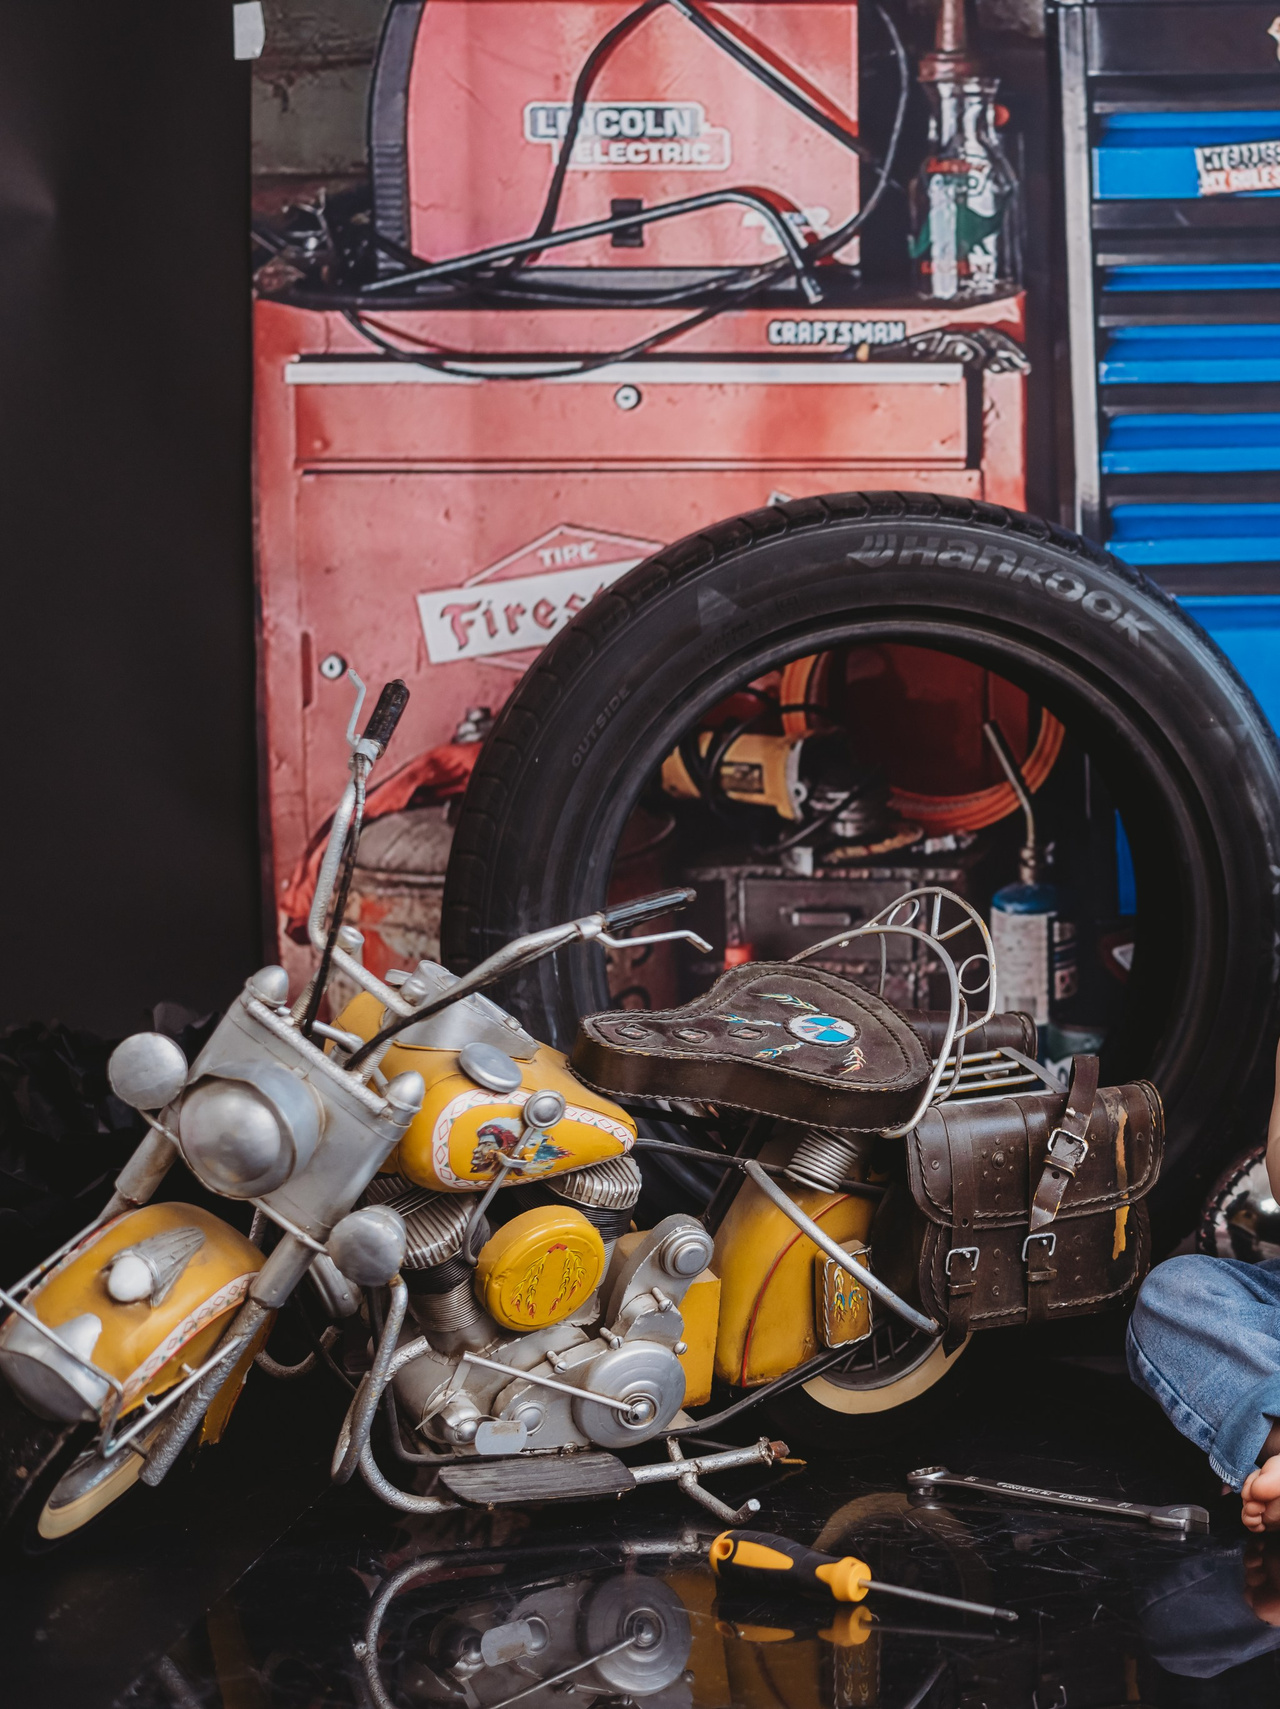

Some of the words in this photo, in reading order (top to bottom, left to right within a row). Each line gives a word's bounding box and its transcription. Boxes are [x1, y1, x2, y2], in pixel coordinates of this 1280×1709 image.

[536, 108, 694, 138] LINCOLN
[575, 142, 712, 165] ELECTRIC
[767, 320, 906, 345] CRAFTSMAN
[537, 541, 599, 567] TIRE
[440, 583, 604, 651] Fires
[571, 687, 631, 768] OUTSIDE
